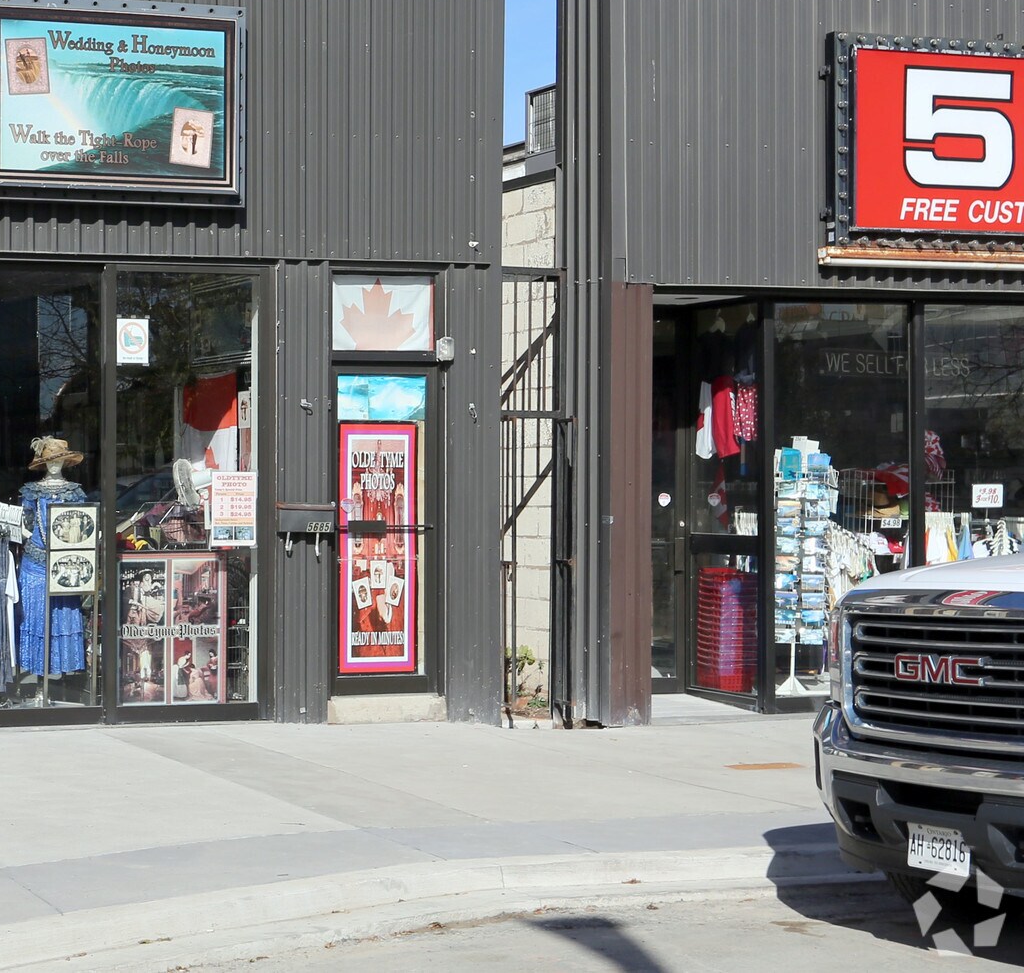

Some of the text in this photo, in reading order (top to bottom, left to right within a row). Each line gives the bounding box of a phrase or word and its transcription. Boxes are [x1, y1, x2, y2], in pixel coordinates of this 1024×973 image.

[47, 30, 216, 60] Wedding & Honeymoon
[109, 56, 156, 74] Photos
[9, 123, 50, 145] Walk
[54, 131, 75, 146] the
[903, 65, 1015, 191] 5
[40, 149, 129, 164] over the Falls
[899, 198, 960, 222] FREE
[826, 353, 851, 373] WE
[856, 354, 893, 375] SELL
[933, 357, 970, 377] LESS
[352, 451, 404, 468] OLDE TYME
[360, 474, 395, 490] PHOTOS
[307, 523, 330, 532] 5685
[121, 624, 216, 639] Olde Tyme Photos
[352, 631, 370, 645] READY
[370, 631, 378, 645] IN
[893, 652, 986, 687] GMC
[910, 833, 967, 863] AH 62816
